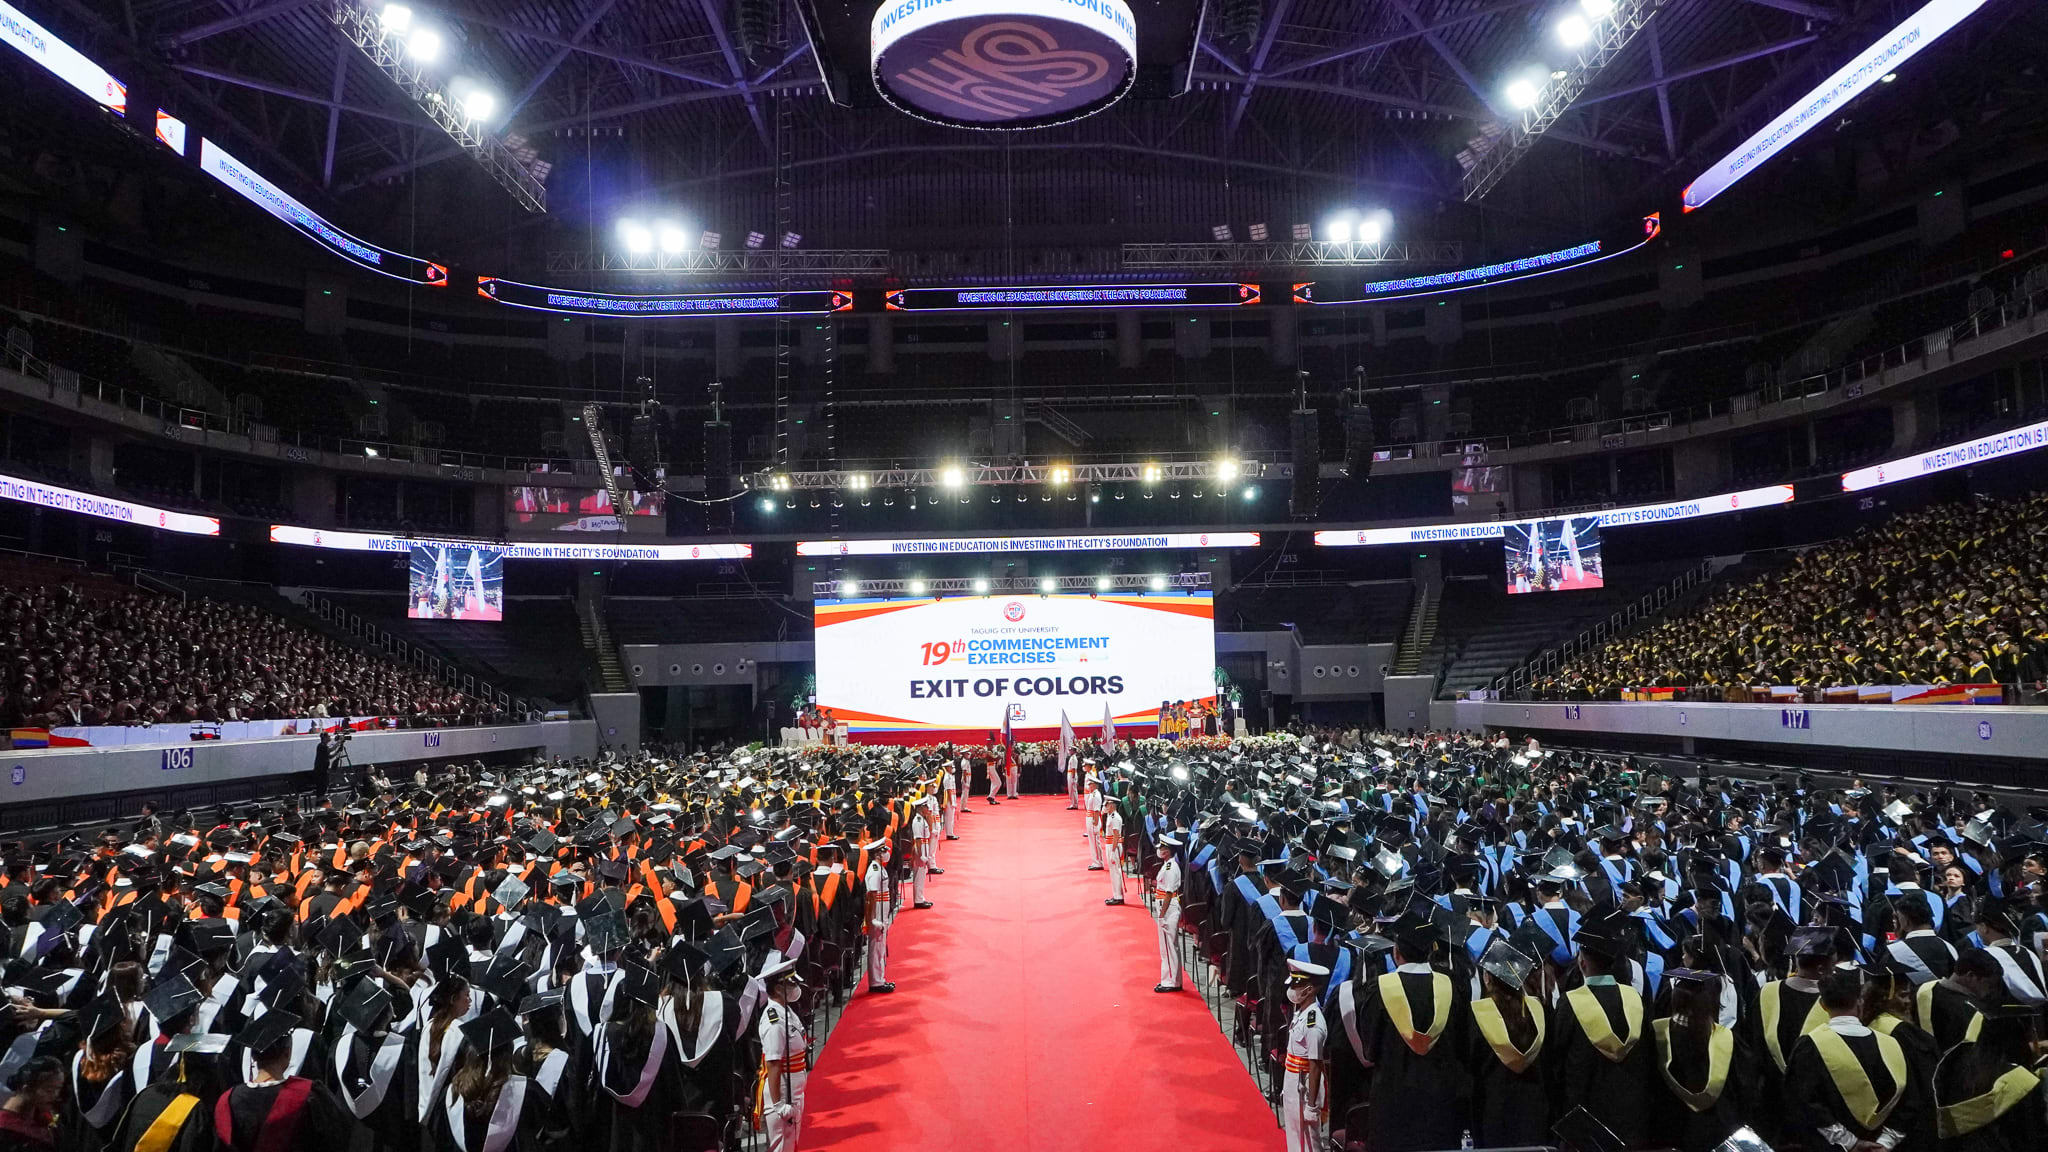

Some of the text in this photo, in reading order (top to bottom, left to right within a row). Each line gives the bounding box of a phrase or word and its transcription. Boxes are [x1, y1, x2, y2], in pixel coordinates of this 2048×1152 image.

[1101, 1, 1112, 19] IS
[1729, 148, 1756, 175] INVESTING
[1756, 143, 1762, 153] IN
[1761, 122, 1794, 151] EDUCATION
[1799, 92, 1832, 124] INVESTING
[1832, 88, 1839, 100] IN
[1839, 77, 1852, 94] THE
[1852, 62, 1873, 85] CITY'S
[1873, 26, 1921, 69] FOUNDATION
[219, 159, 249, 186] INVESTING
[248, 178, 256, 192] IN
[255, 183, 284, 210] EDUCATION
[1366, 280, 1406, 293] INVESTING
[1465, 265, 1504, 280] INVESTING
[1513, 258, 1528, 270] THE
[1552, 240, 1601, 262] FOUNDATION
[548, 294, 588, 307] INVESTING
[647, 300, 686, 311] INVESTING
[686, 300, 695, 310] IN
[695, 299, 708, 310] THE
[708, 299, 732, 309] CITY'S
[732, 297, 778, 308] FOUNDATION
[958, 292, 996, 302] INVESTING
[997, 292, 1006, 302] IN
[1048, 291, 1055, 301] IS
[1054, 290, 1093, 301] INVESTING
[1094, 290, 1102, 300] IN
[1103, 290, 1117, 300] THE
[1117, 289, 1140, 300] CITY'S
[1140, 288, 1187, 299] FOUNDATION
[1923, 448, 1967, 471] INVESTING
[1968, 446, 1977, 460] IN
[1978, 431, 2032, 457] EDUCATION
[2033, 429, 2042, 444] IS
[26, 486, 36, 501] IN
[37, 489, 54, 505] THE
[55, 493, 81, 510] CITY'S
[82, 498, 133, 520] FOUNDATION
[1611, 511, 1640, 524] CITY'S
[1642, 503, 1701, 520] FOUNDATION
[1411, 526, 1504, 540] INVESTING IN EDUCA
[543, 547, 552, 557] IN
[554, 547, 572, 557] THE
[573, 547, 600, 558] CITY'S
[602, 547, 660, 559] FOUNDATION
[892, 537, 1168, 553] INVESTING IN EDUCATION IS INVESTING IN THE CITY'S FOUNDATION
[392, 559, 410, 570] 20
[971, 626, 1059, 635] TAGUIG CITY UNIVERSITY
[920, 636, 1110, 666] 19th COMMENCEMENT
[968, 652, 1056, 665] EXERCISES
[910, 675, 1124, 699] EXIT OF COLORS
[1567, 706, 1579, 720] 116
[1785, 710, 1805, 729] 117
[426, 732, 440, 747] 107
[164, 748, 190, 769] 106
